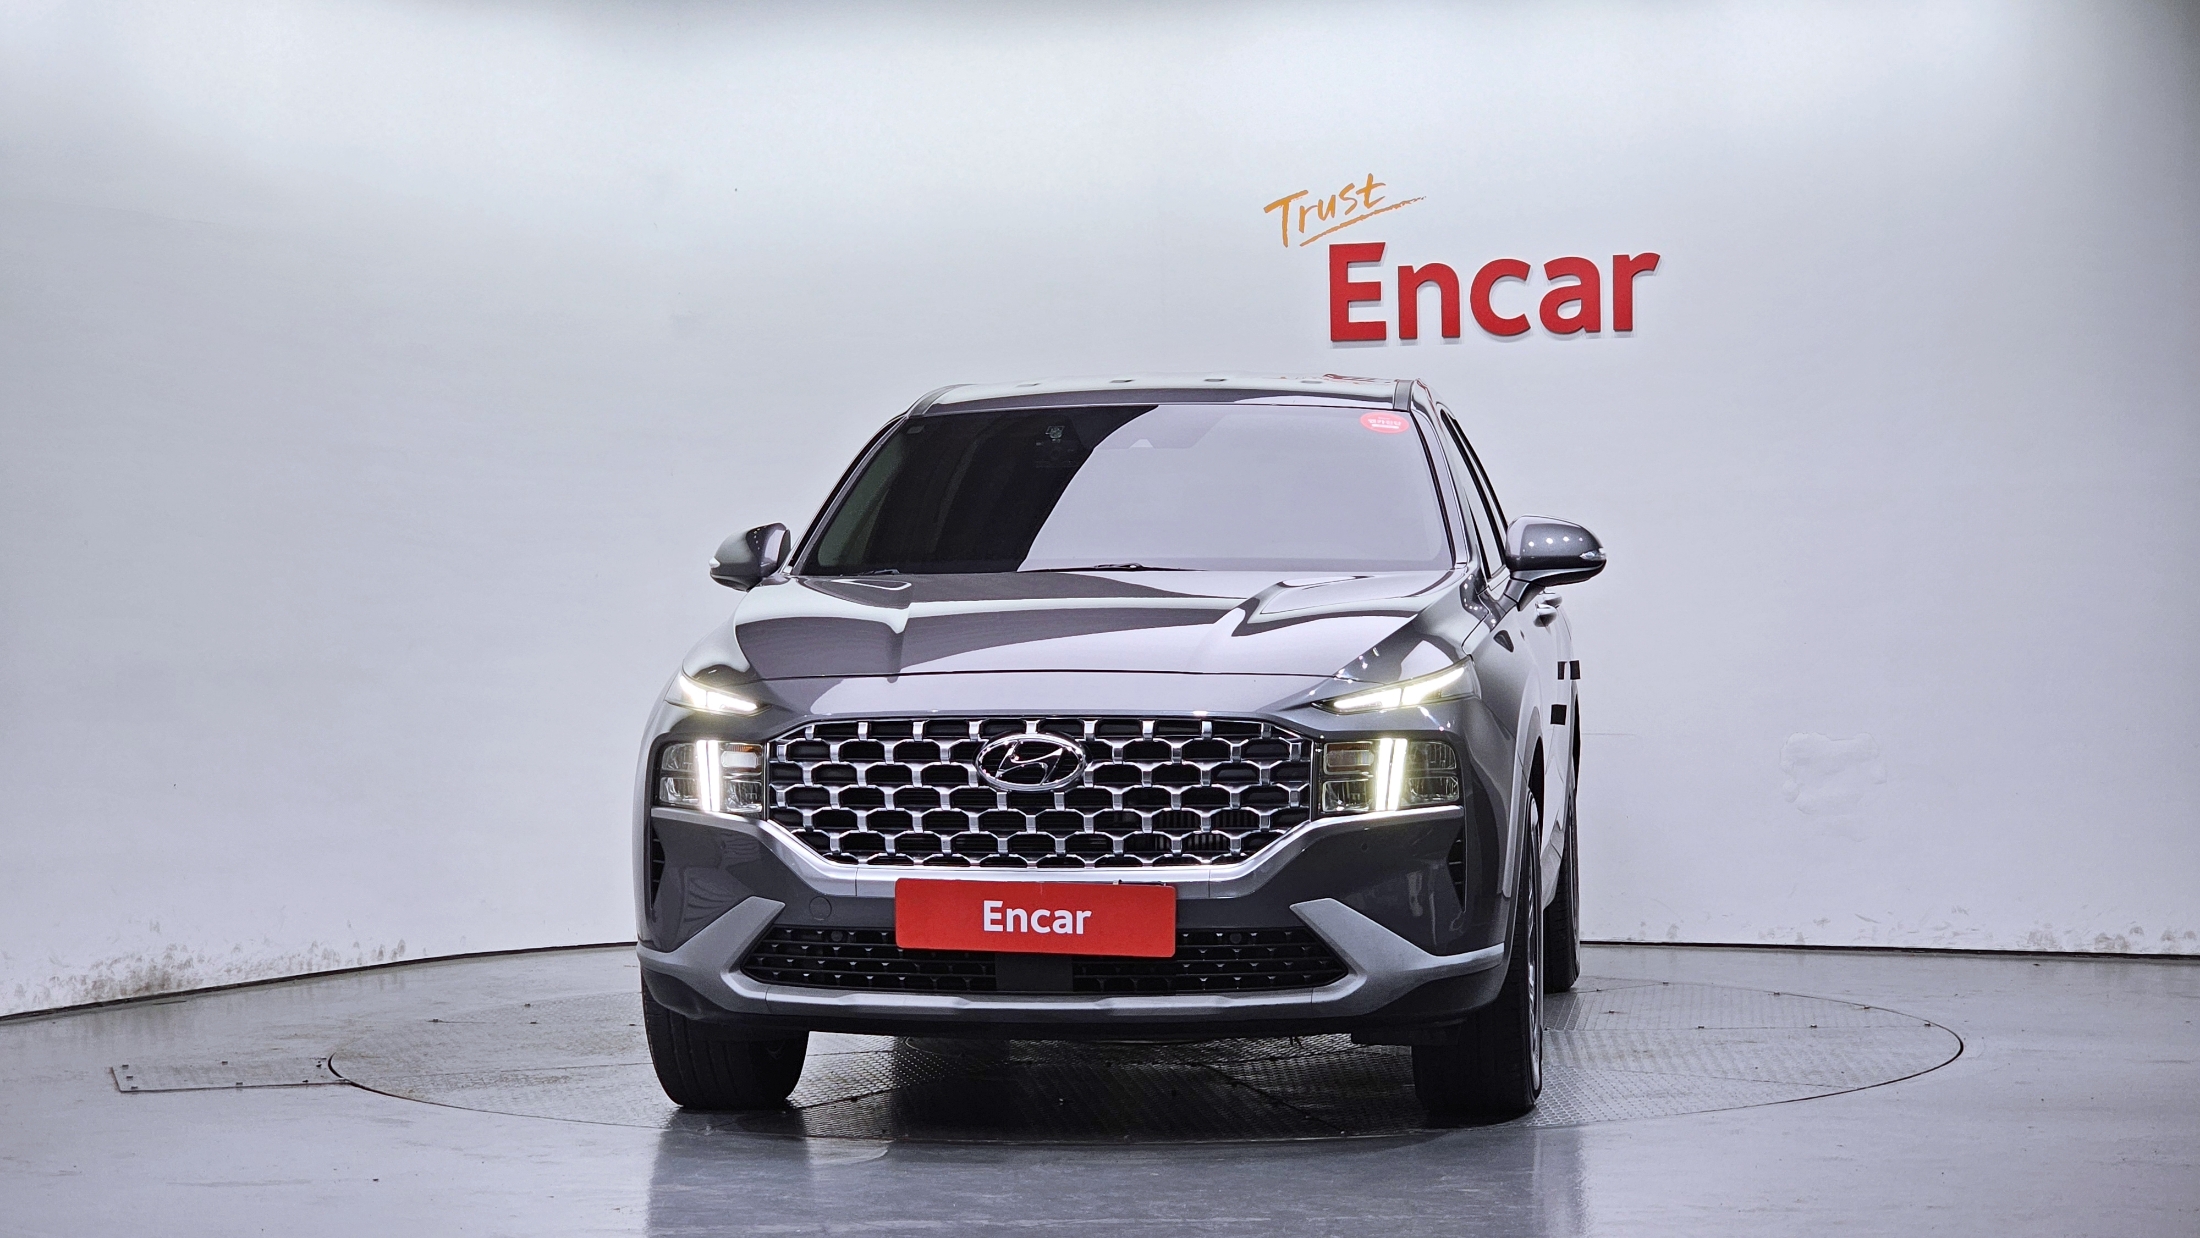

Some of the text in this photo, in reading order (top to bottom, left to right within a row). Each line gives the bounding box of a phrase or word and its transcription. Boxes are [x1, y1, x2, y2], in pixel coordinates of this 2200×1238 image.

[1263, 173, 1387, 248] Trust
[1329, 242, 1661, 342] Encar
[983, 900, 1092, 935] Encar
